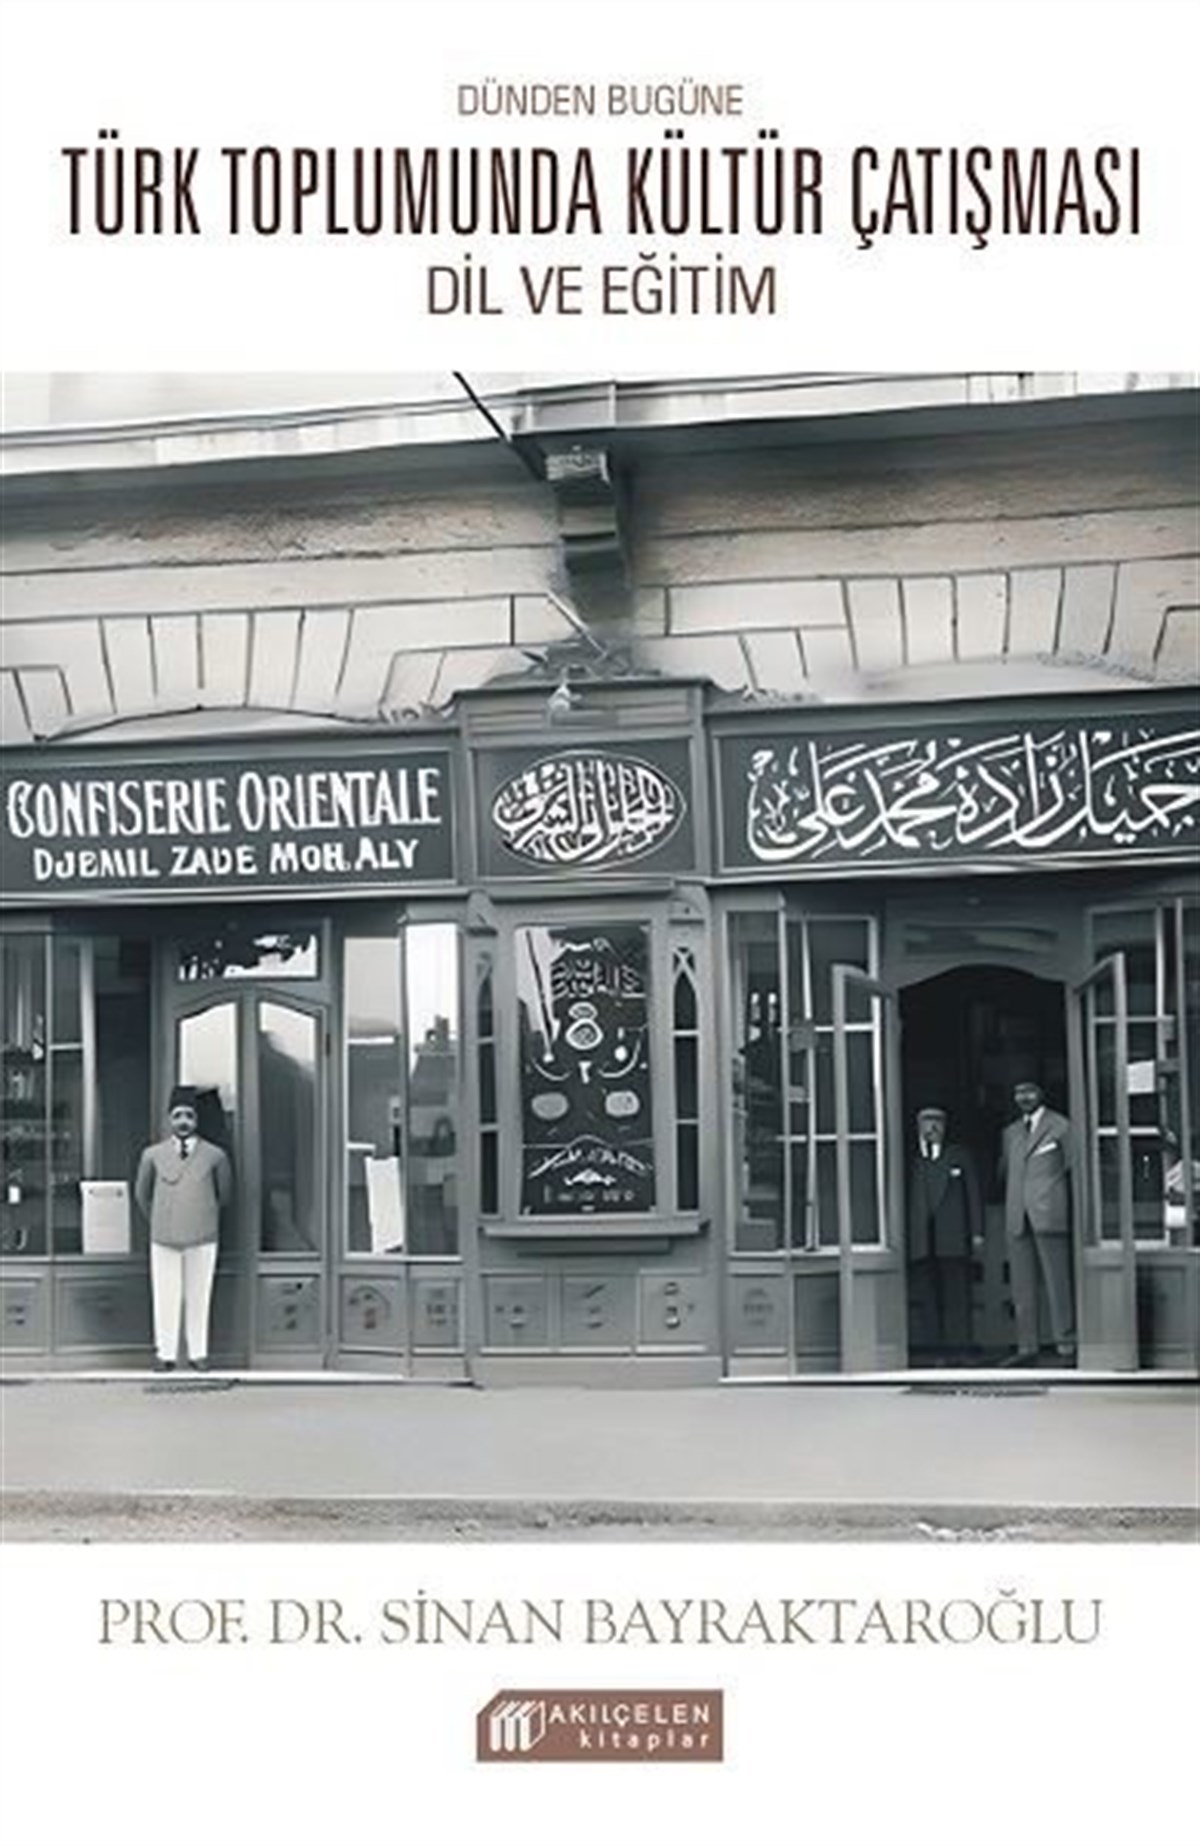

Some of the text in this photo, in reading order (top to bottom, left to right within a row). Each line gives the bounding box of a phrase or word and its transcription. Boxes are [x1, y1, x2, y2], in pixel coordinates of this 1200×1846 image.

[7, 777, 232, 839] CONFISERIE
[237, 767, 443, 833] ORIENTALE
[169, 845, 259, 876] ZADE
